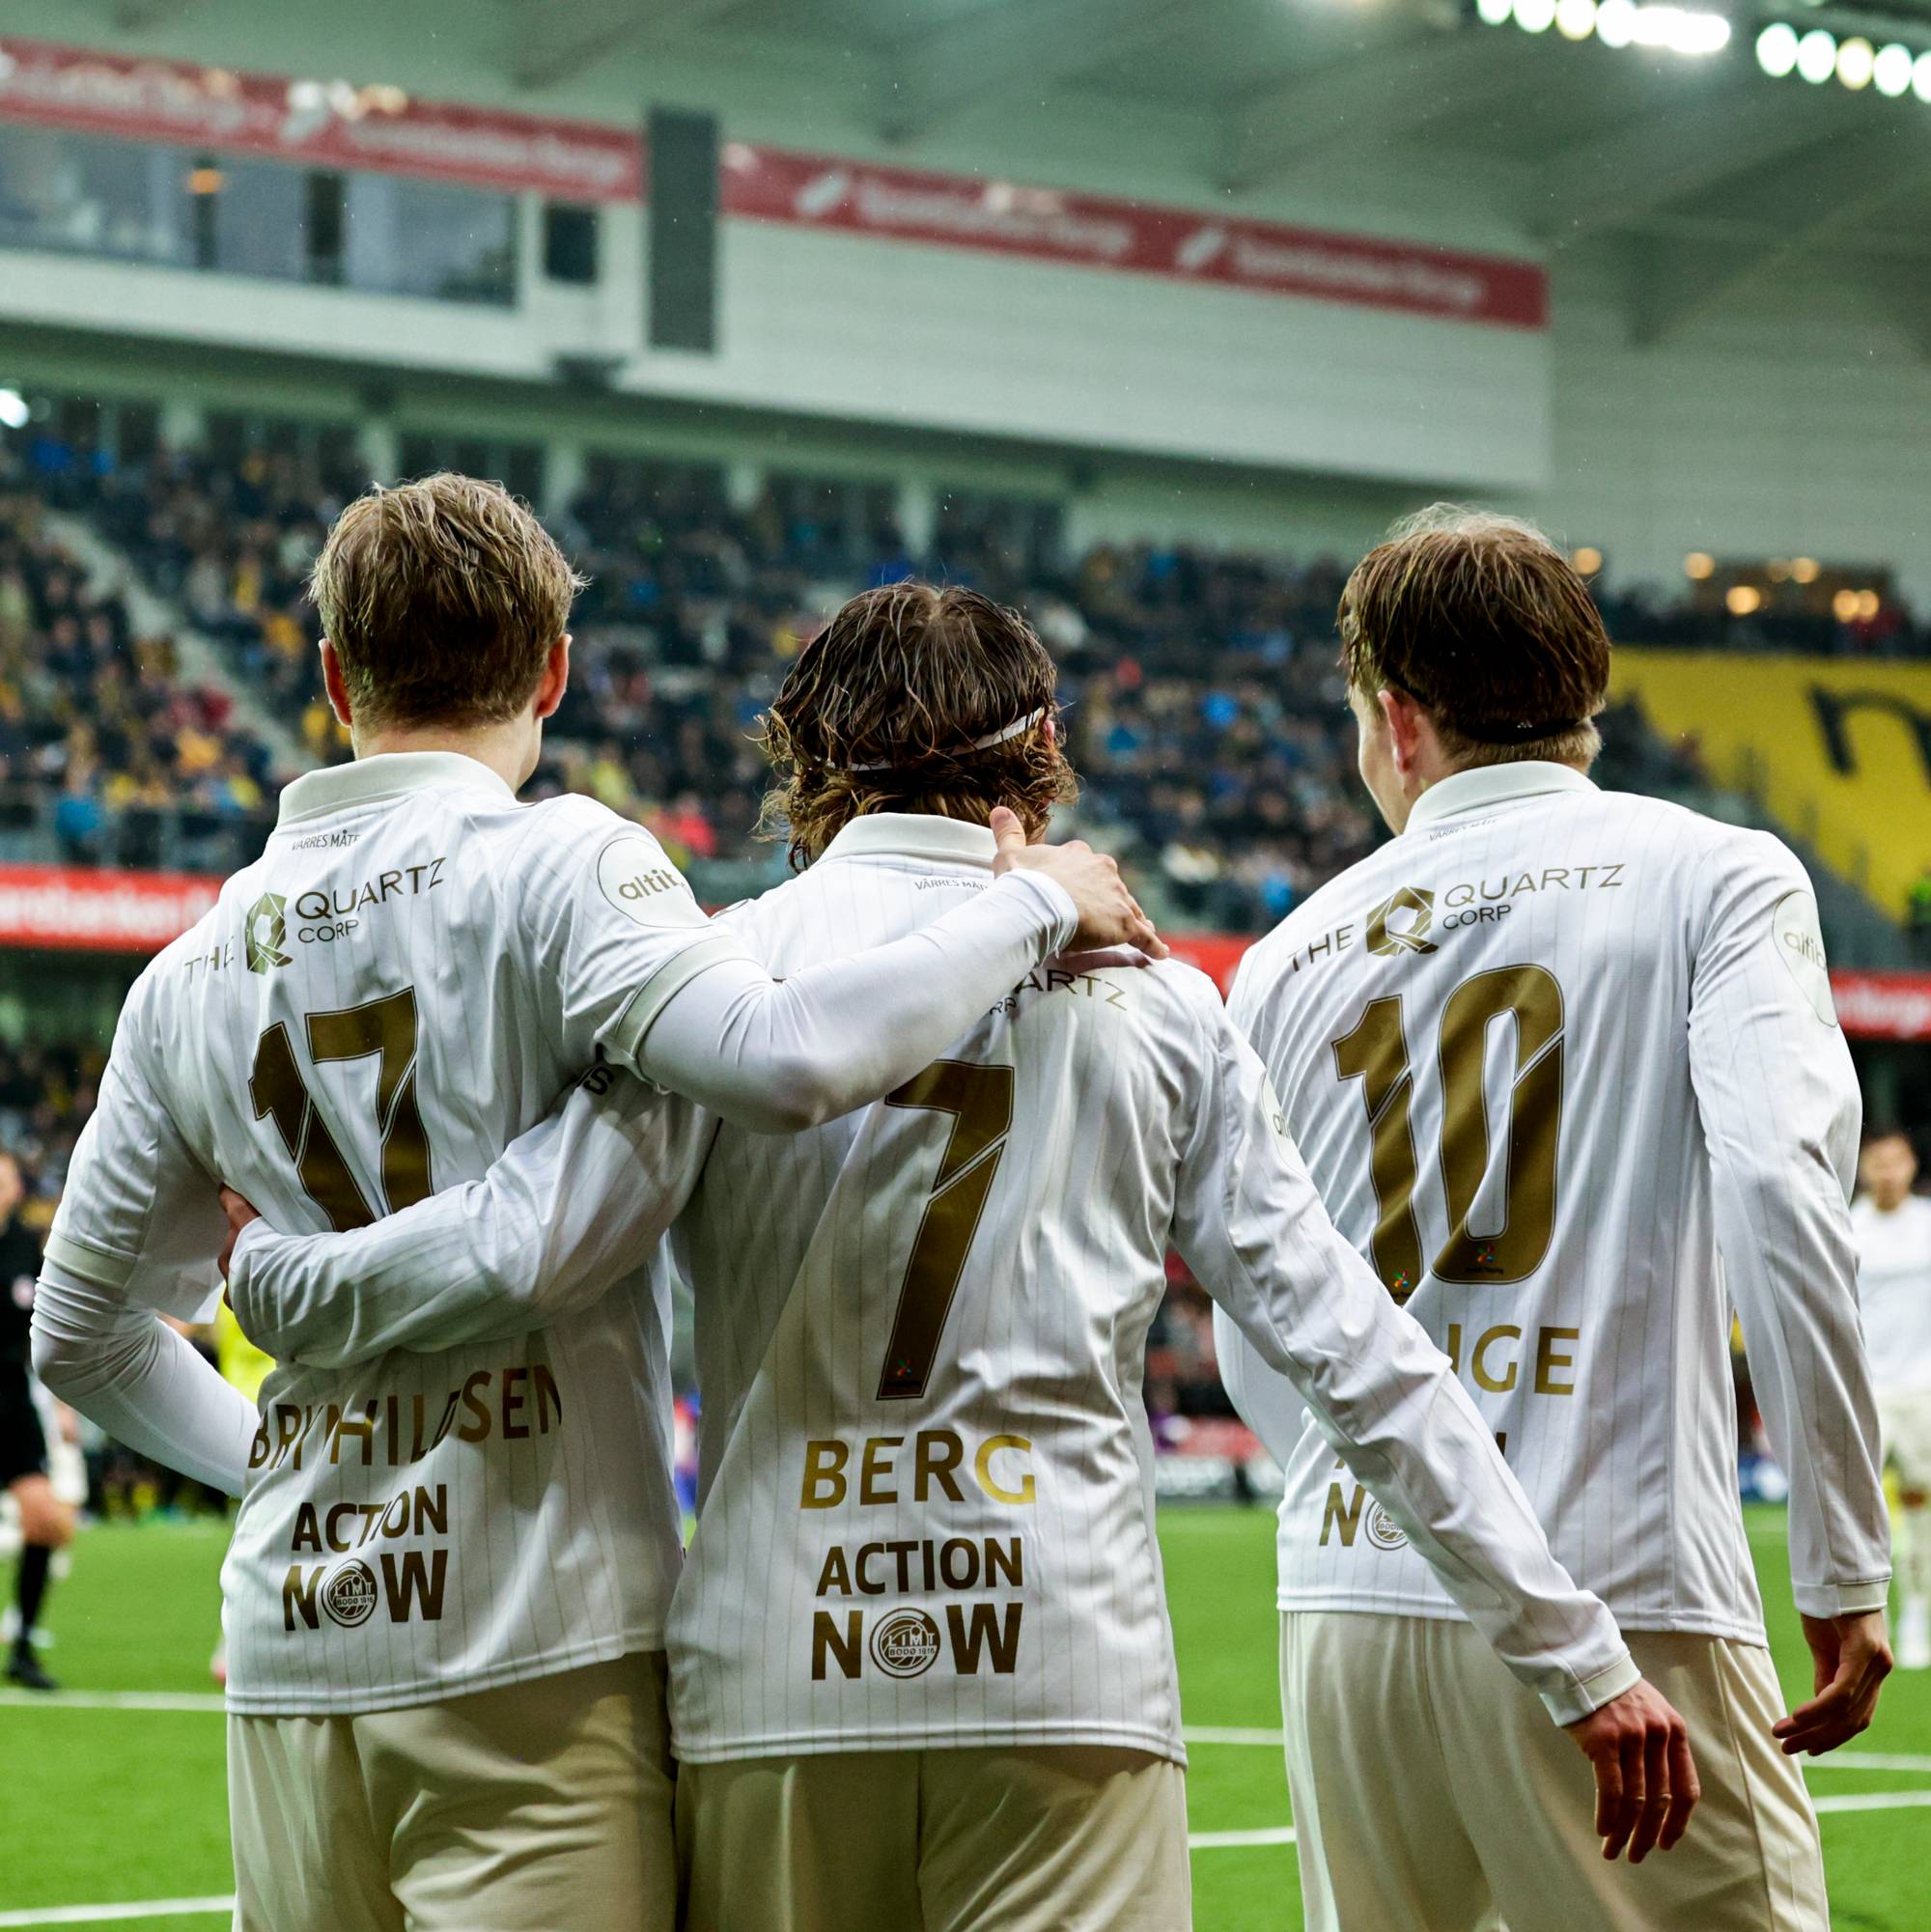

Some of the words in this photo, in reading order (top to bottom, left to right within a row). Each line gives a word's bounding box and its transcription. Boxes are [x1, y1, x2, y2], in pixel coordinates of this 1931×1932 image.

[294, 857, 446, 919] QUARTZ
[1287, 924, 1354, 972] THE
[1443, 863, 1626, 909] QUARTZ
[1442, 905, 1512, 931] CORP
[297, 919, 359, 944] CORP
[248, 985, 434, 1232] 17
[1330, 964, 1566, 1306] 10
[877, 1059, 1014, 1400] 7
[799, 1430, 1036, 1509] BERG
[291, 1483, 448, 1554] ACTION
[816, 1537, 1023, 1596] ACTION
